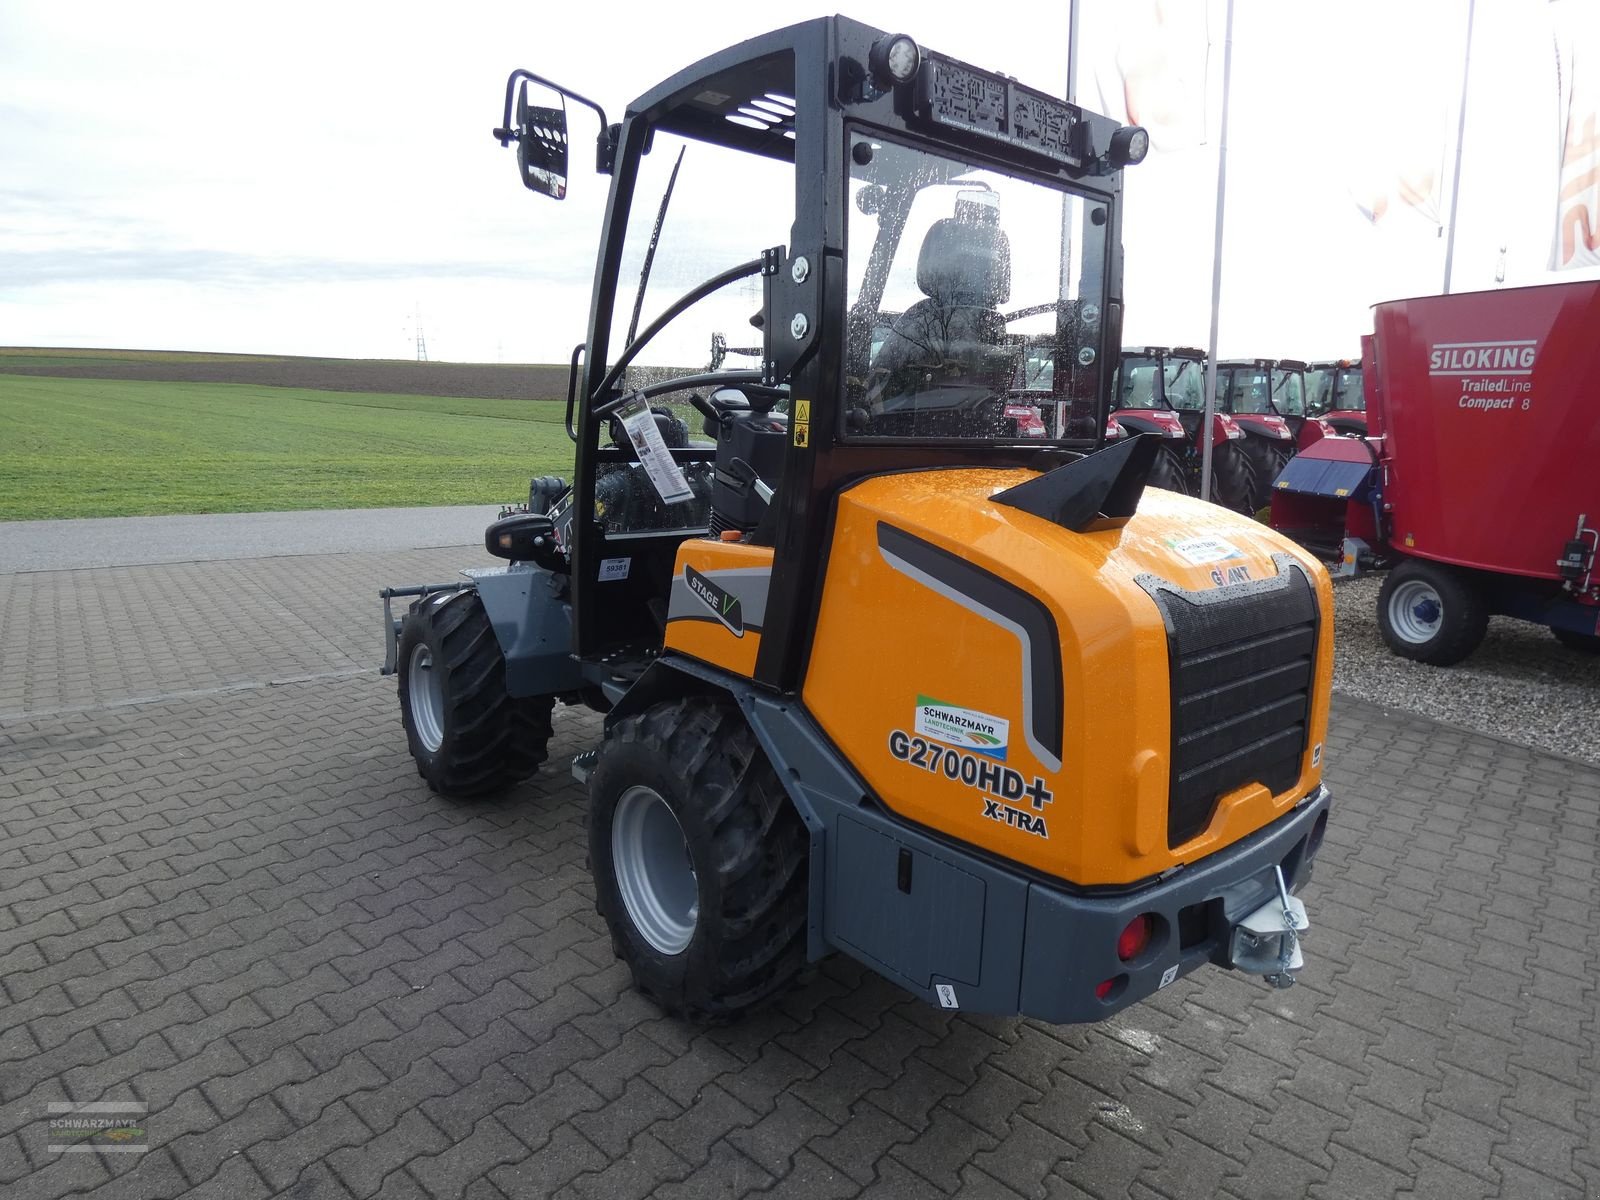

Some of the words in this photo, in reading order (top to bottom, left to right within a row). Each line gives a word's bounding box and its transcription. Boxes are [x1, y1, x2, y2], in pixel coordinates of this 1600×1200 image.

[1430, 347, 1536, 370] SILOKING
[1461, 378, 1532, 393] TrailedLine
[1458, 395, 1515, 412] Compact
[1521, 398, 1531, 411] 8
[691, 576, 719, 609] STAGE
[923, 706, 995, 736] SCHWARZMAYR
[923, 717, 965, 735] LANDTECHNIK
[889, 728, 1054, 811] G2700HD+
[982, 796, 1049, 839] X-TRA
